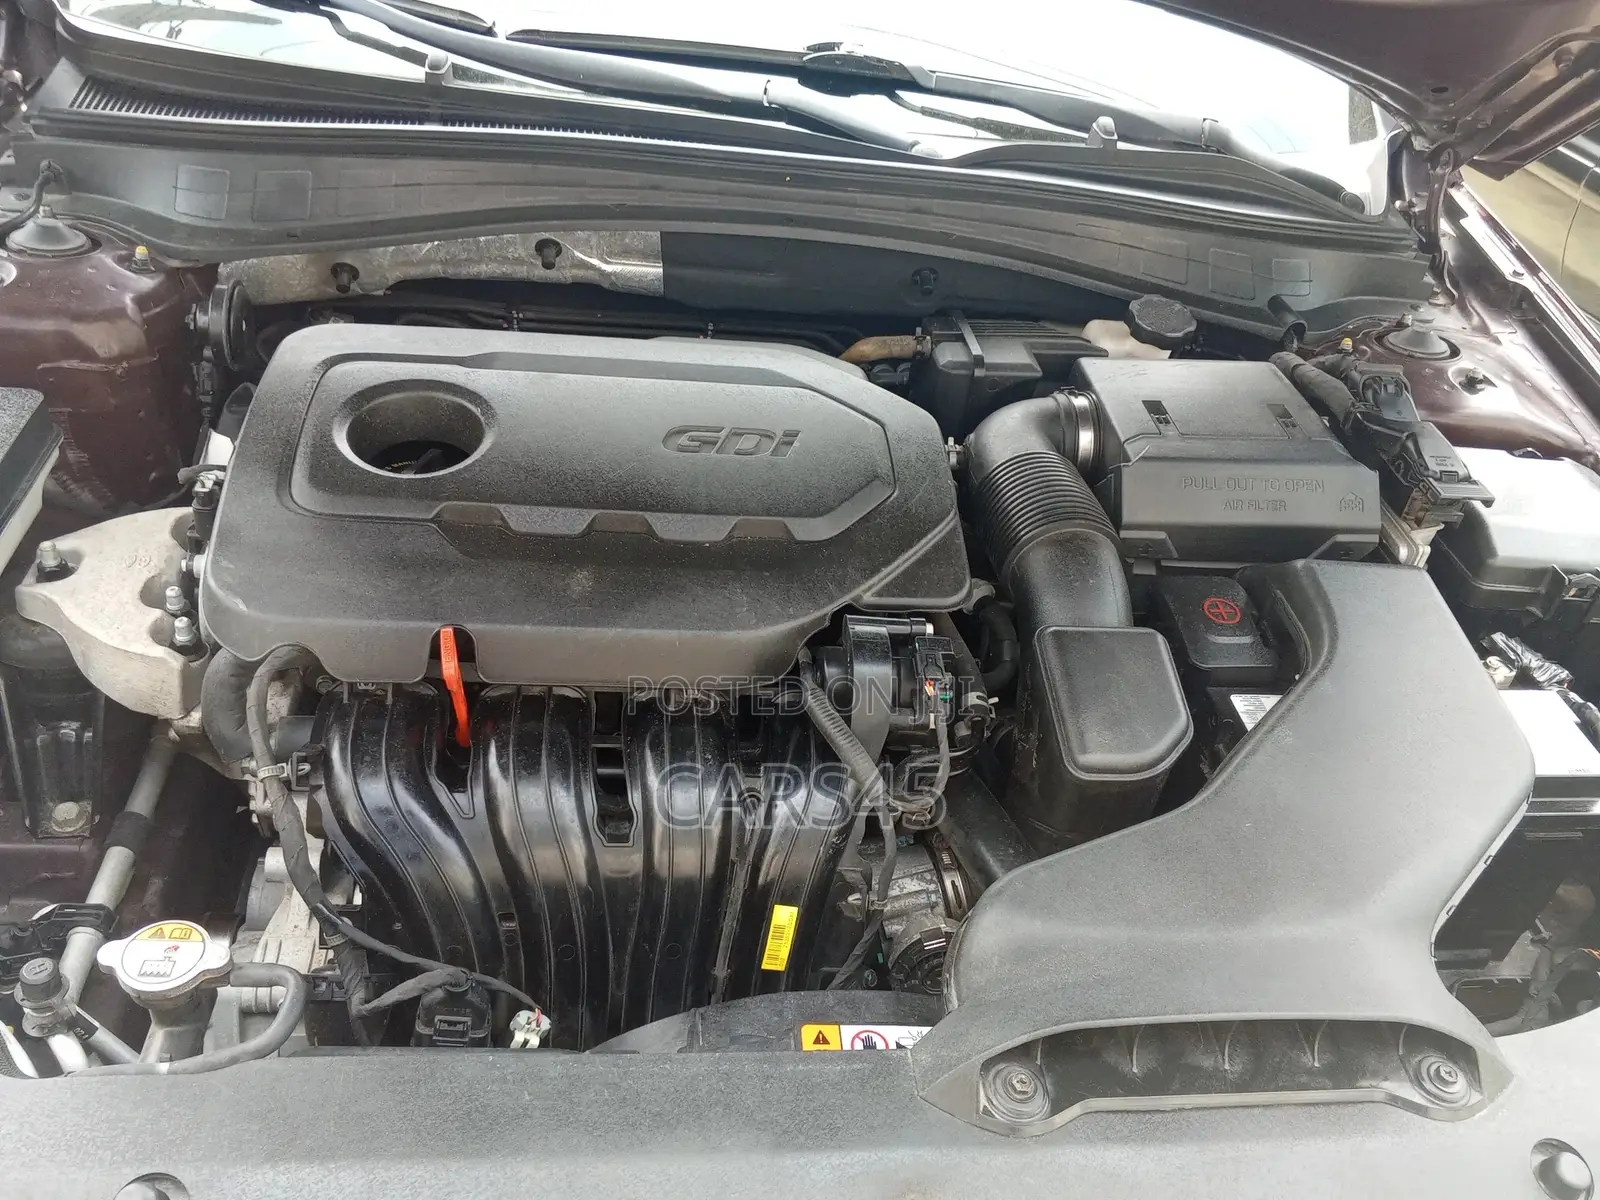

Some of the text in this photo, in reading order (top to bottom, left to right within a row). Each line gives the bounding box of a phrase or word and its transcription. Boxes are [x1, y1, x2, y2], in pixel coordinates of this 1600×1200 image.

[1182, 476, 1325, 493] PULL OUT TO OPEN
[1223, 499, 1287, 512] AIR FILTER
